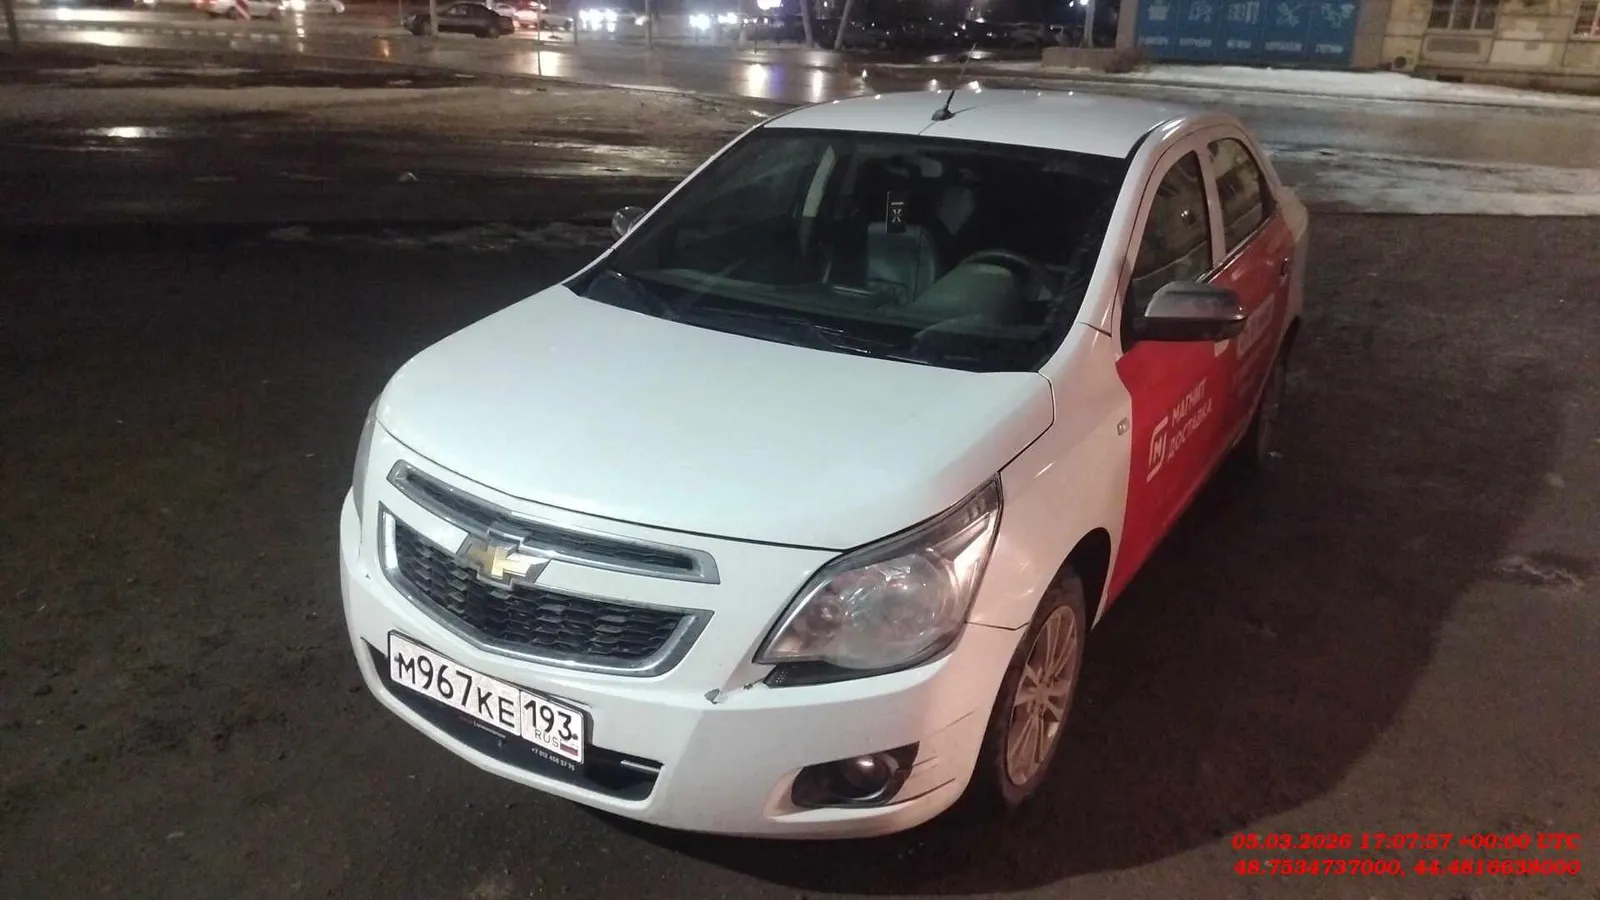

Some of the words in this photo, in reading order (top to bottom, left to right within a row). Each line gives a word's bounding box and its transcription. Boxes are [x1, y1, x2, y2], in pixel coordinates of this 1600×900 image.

[1171, 376, 1206, 428] МАГНИТ
[523, 699, 572, 741] 193
[534, 728, 559, 748] RUS
